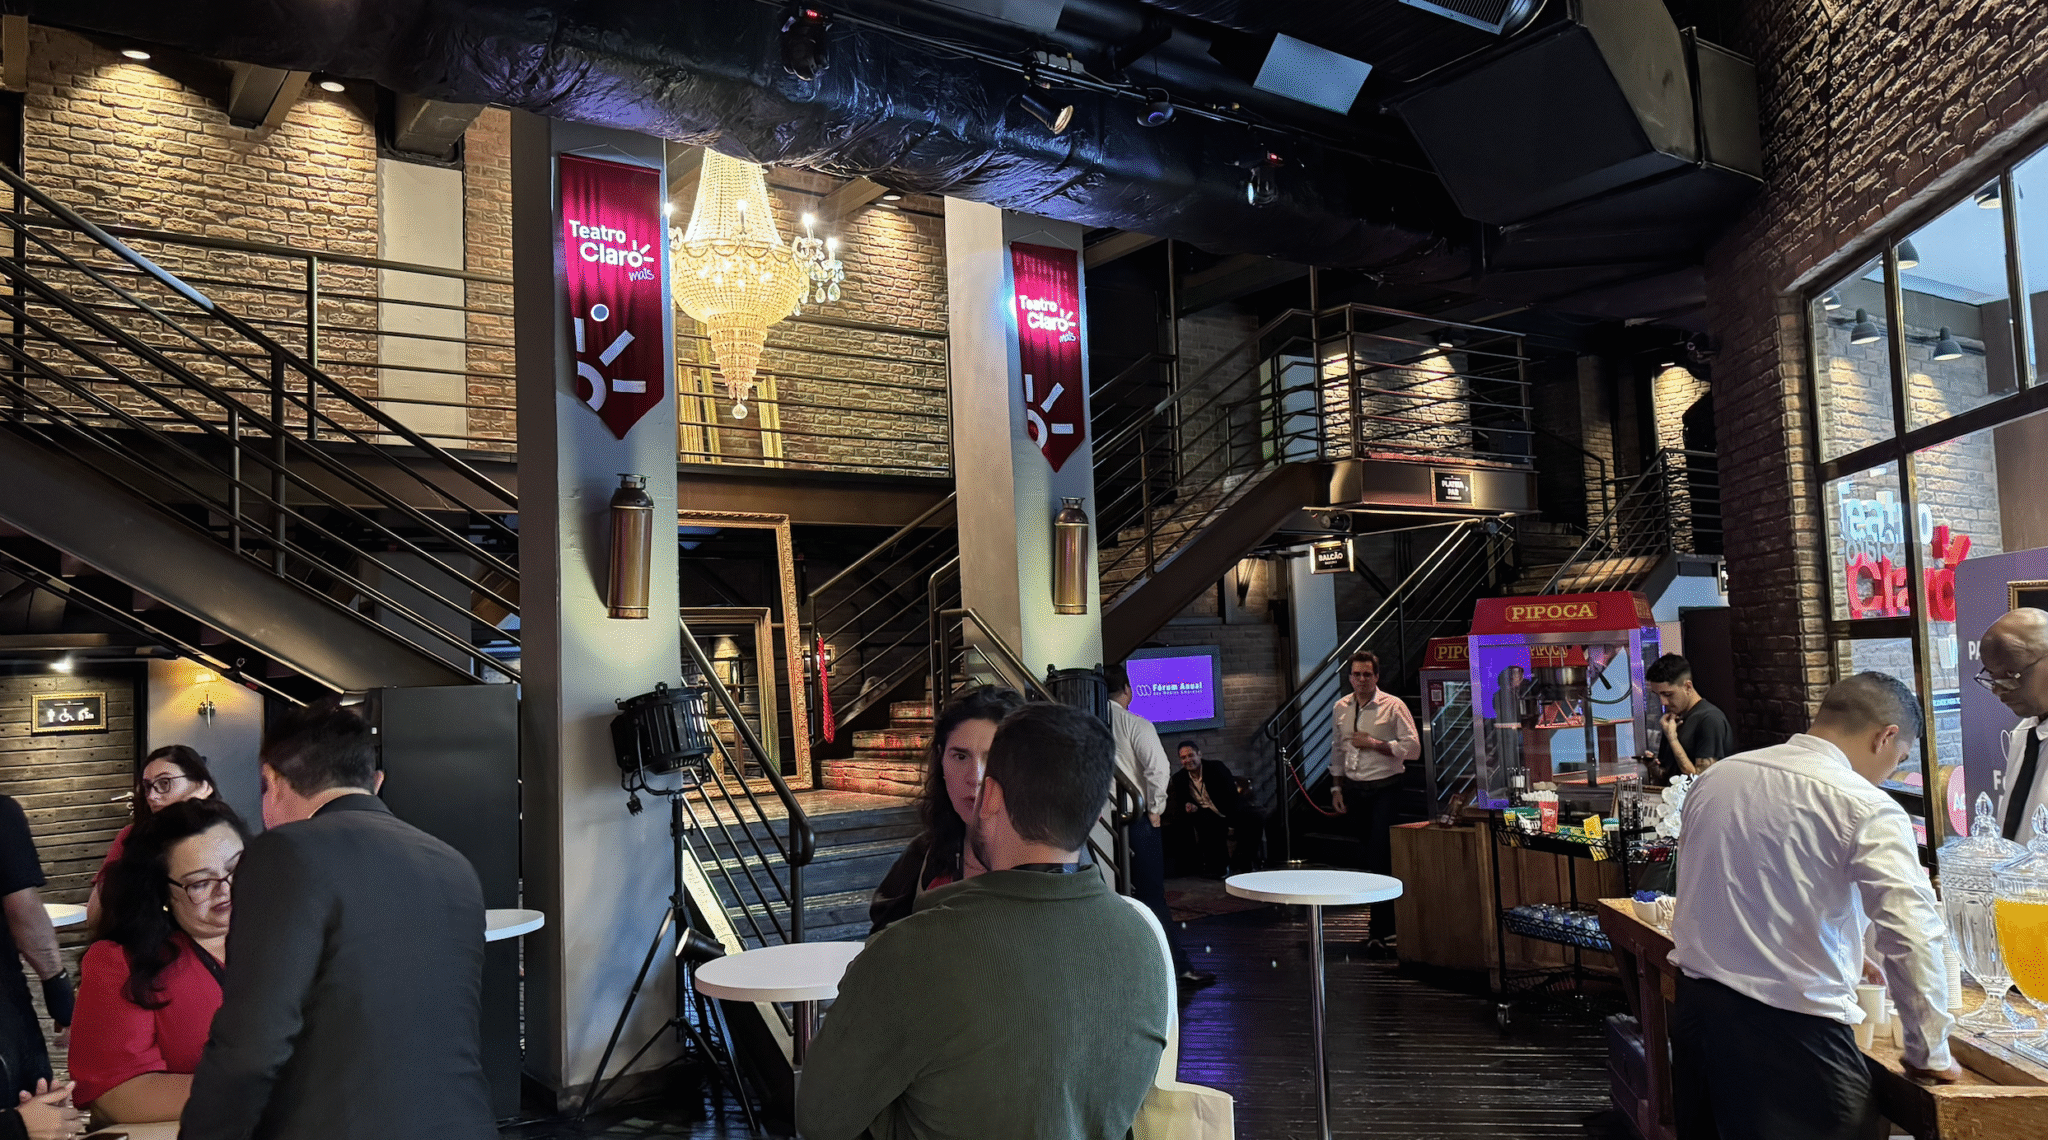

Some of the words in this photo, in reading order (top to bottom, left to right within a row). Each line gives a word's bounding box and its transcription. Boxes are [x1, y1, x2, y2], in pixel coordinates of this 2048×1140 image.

[569, 219, 626, 244] Teatro
[580, 241, 643, 268] Claro
[628, 268, 655, 282] mais
[1019, 295, 1058, 312] Teatro
[1027, 311, 1069, 332] Claro
[1318, 551, 1344, 562] BALCÃO
[1511, 603, 1595, 620] PIPOCA
